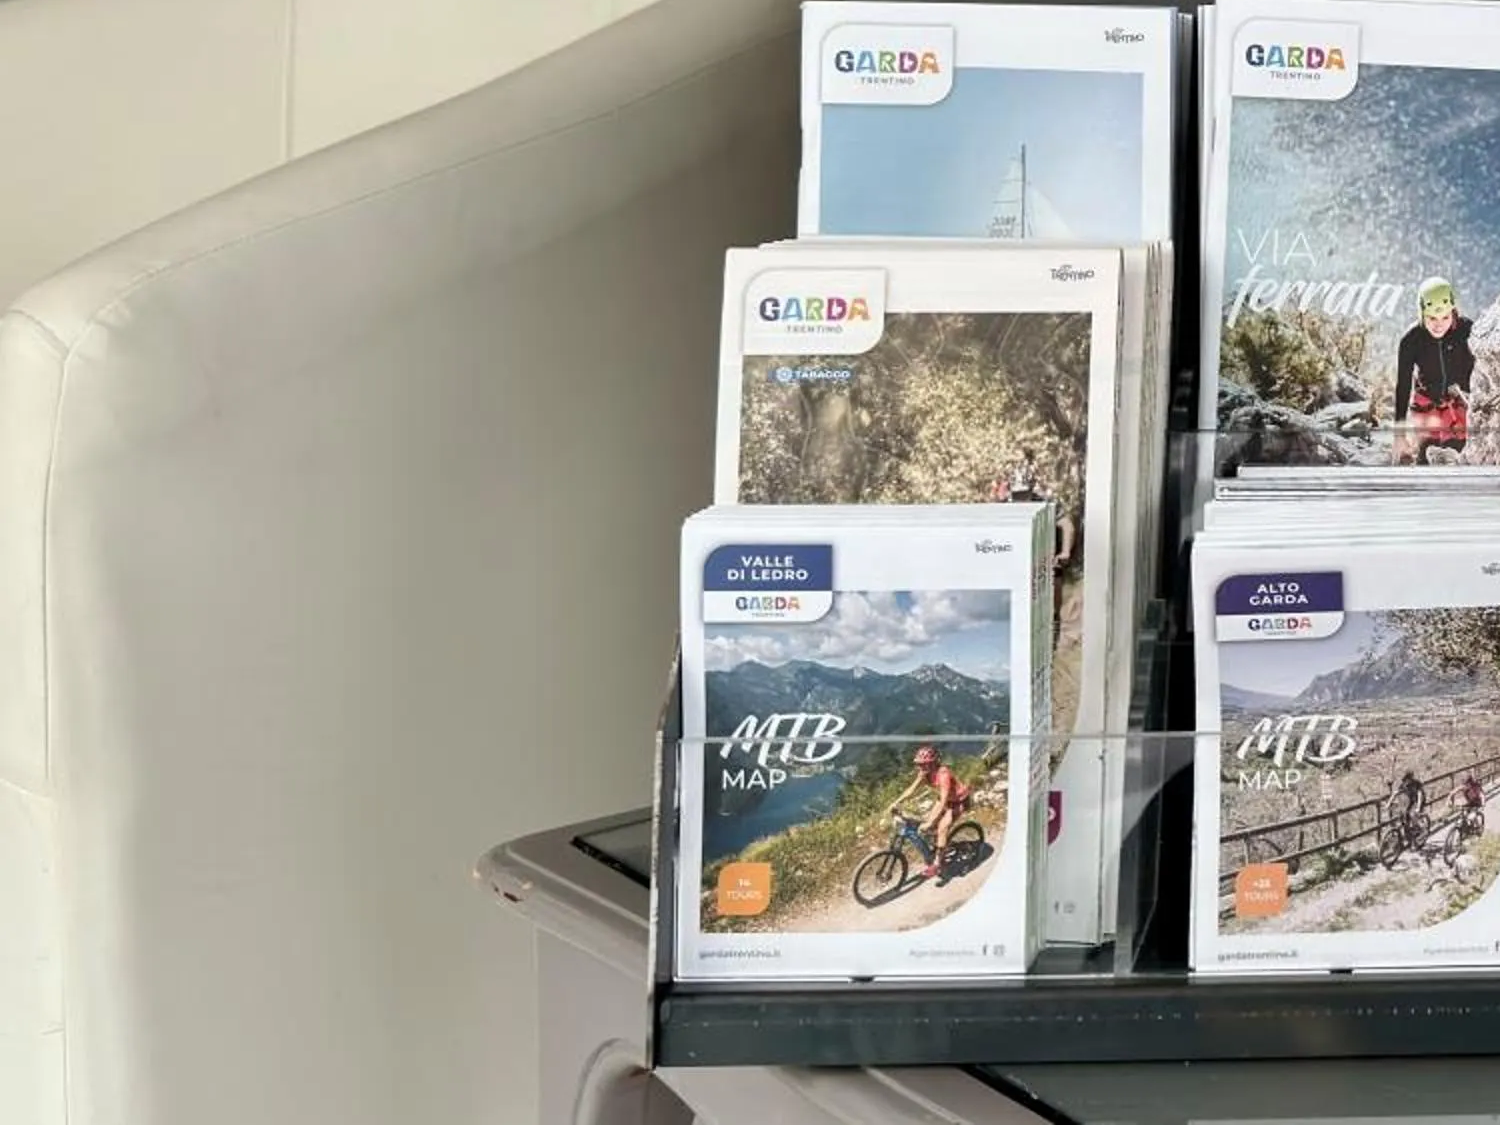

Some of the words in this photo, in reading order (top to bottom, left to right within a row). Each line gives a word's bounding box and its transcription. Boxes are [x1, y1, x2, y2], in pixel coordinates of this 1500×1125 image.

[834, 50, 941, 75] GARDA
[1245, 44, 1346, 71] GARDA
[860, 76, 915, 86] TRENTINO
[1270, 70, 1321, 81] TRENTINO
[1237, 227, 1317, 267] VIA
[1227, 264, 1403, 329] ferrata
[758, 296, 871, 323] GARDA
[786, 324, 843, 335] TRENTINO
[740, 555, 794, 568] VALLE
[727, 569, 746, 581] DI
[751, 569, 809, 581] LEDRO
[1257, 582, 1300, 594] ALTO
[735, 596, 801, 611] GARDA
[1249, 594, 1309, 606] GARDA
[1248, 617, 1312, 631] GARDA
[719, 713, 847, 768] MTB
[1237, 714, 1359, 767] MTB
[721, 769, 787, 790] MAP
[1238, 768, 1302, 791] MAP
